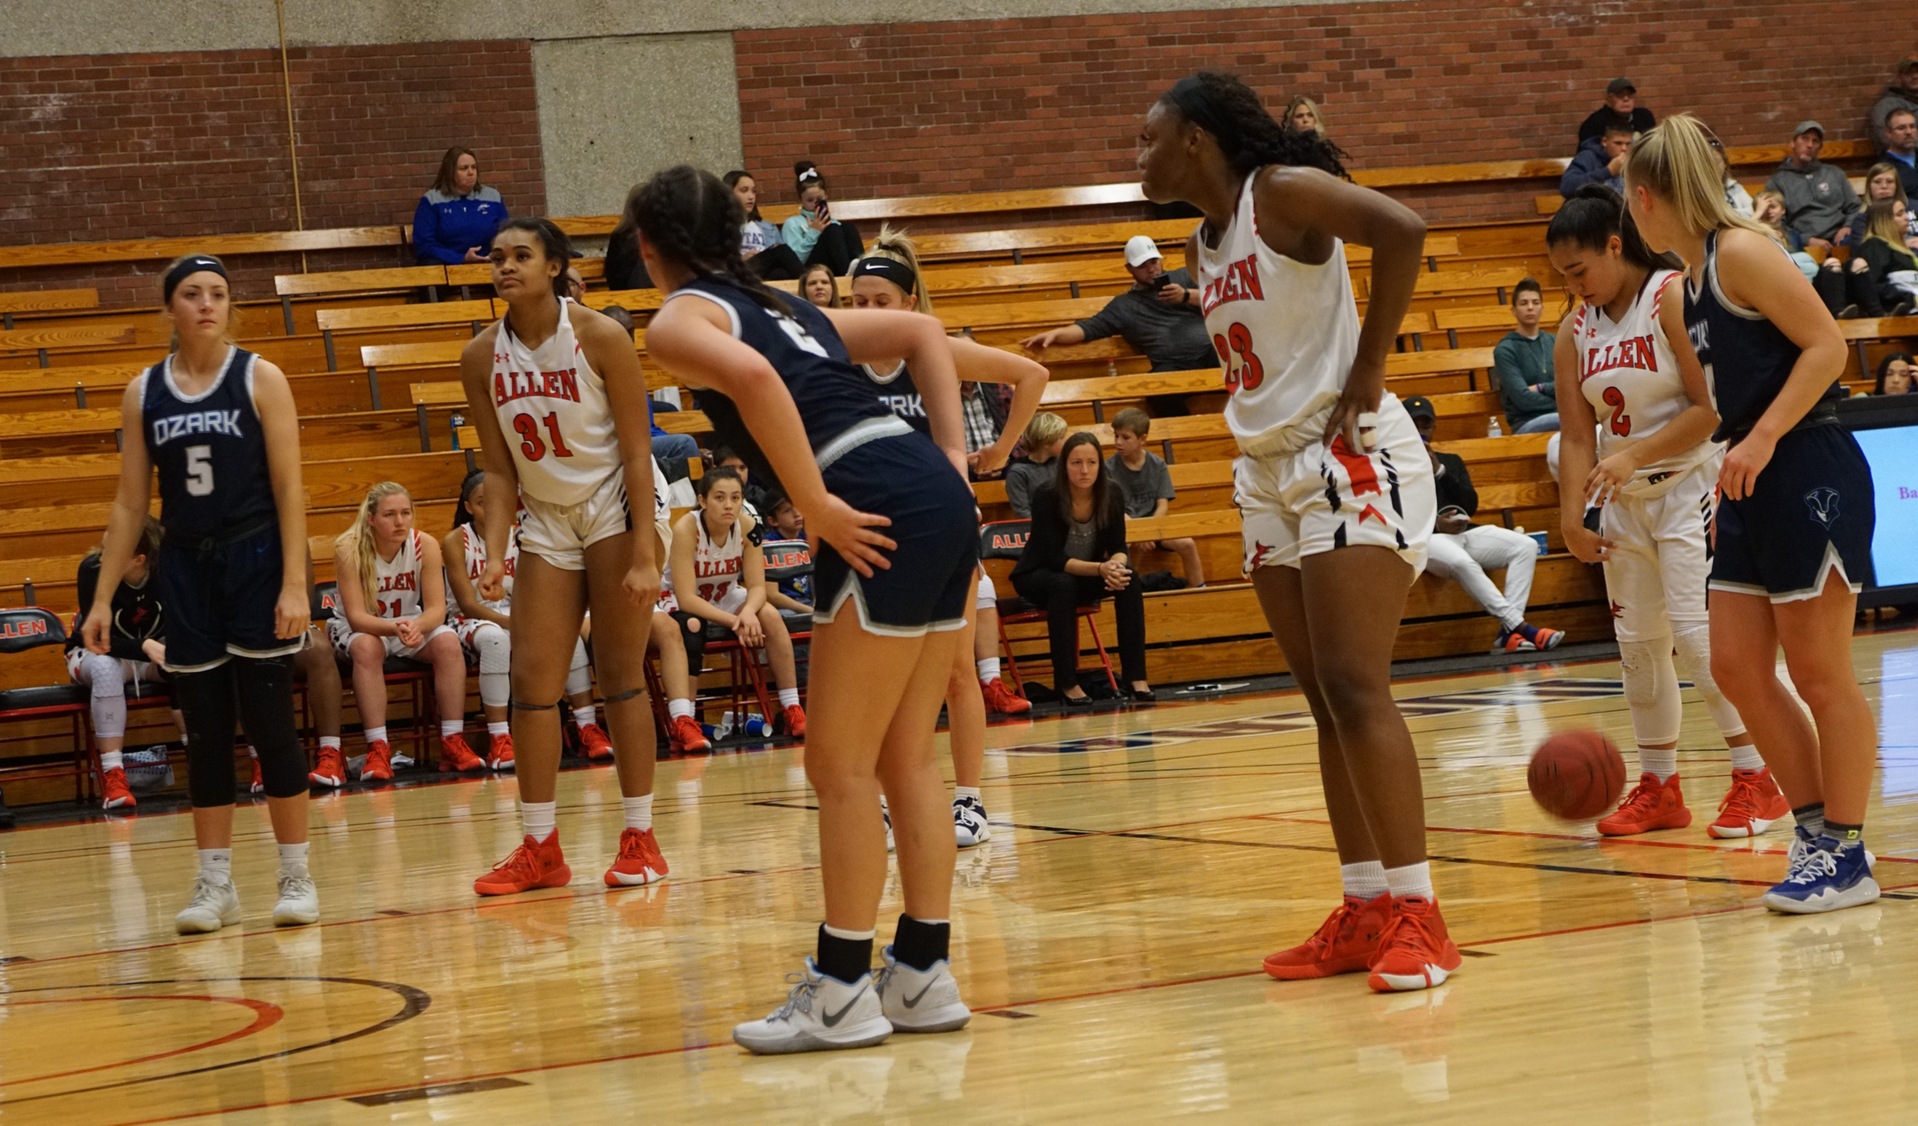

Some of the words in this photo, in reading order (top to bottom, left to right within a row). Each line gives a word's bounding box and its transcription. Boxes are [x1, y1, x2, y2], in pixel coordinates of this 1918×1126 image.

[1202, 253, 1265, 320] LLEN
[1213, 321, 1265, 396] 23
[1581, 334, 1658, 382] LLEN
[495, 368, 581, 408] ALLEN
[1602, 386, 1631, 437] 2
[153, 408, 243, 446] OZARK
[513, 411, 574, 462] 31
[185, 444, 215, 496] 5
[763, 550, 810, 569] LLEN
[992, 532, 1031, 549] ALL
